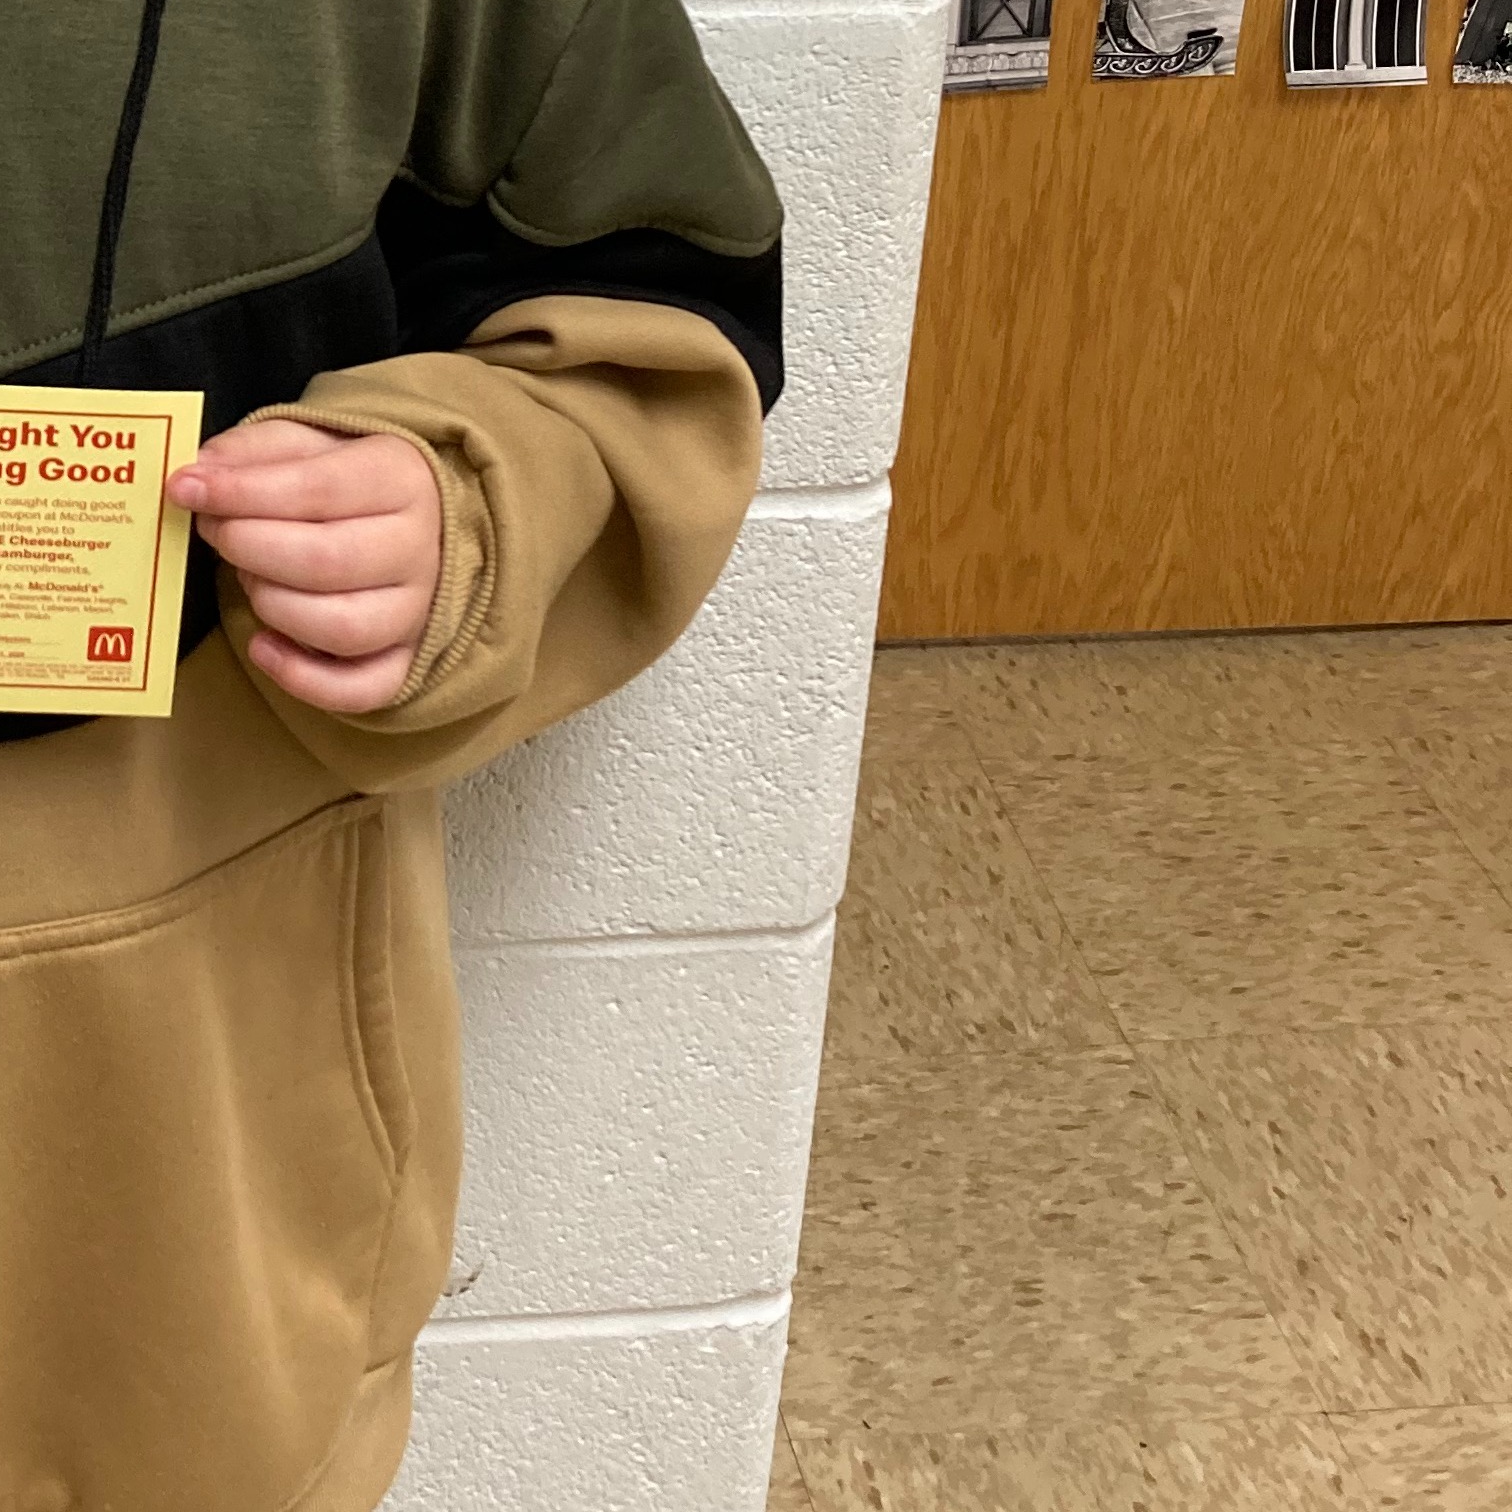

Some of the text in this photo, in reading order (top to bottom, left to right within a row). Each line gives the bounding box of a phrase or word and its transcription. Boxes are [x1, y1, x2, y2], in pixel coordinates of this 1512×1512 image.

[70, 424, 136, 450] You
[38, 457, 136, 484] Good
[4, 496, 48, 509] caught
[51, 498, 87, 510] doing
[44, 511, 56, 521] at
[35, 525, 59, 536] you
[61, 525, 75, 535] to
[9, 534, 112, 551] Cheeseburger
